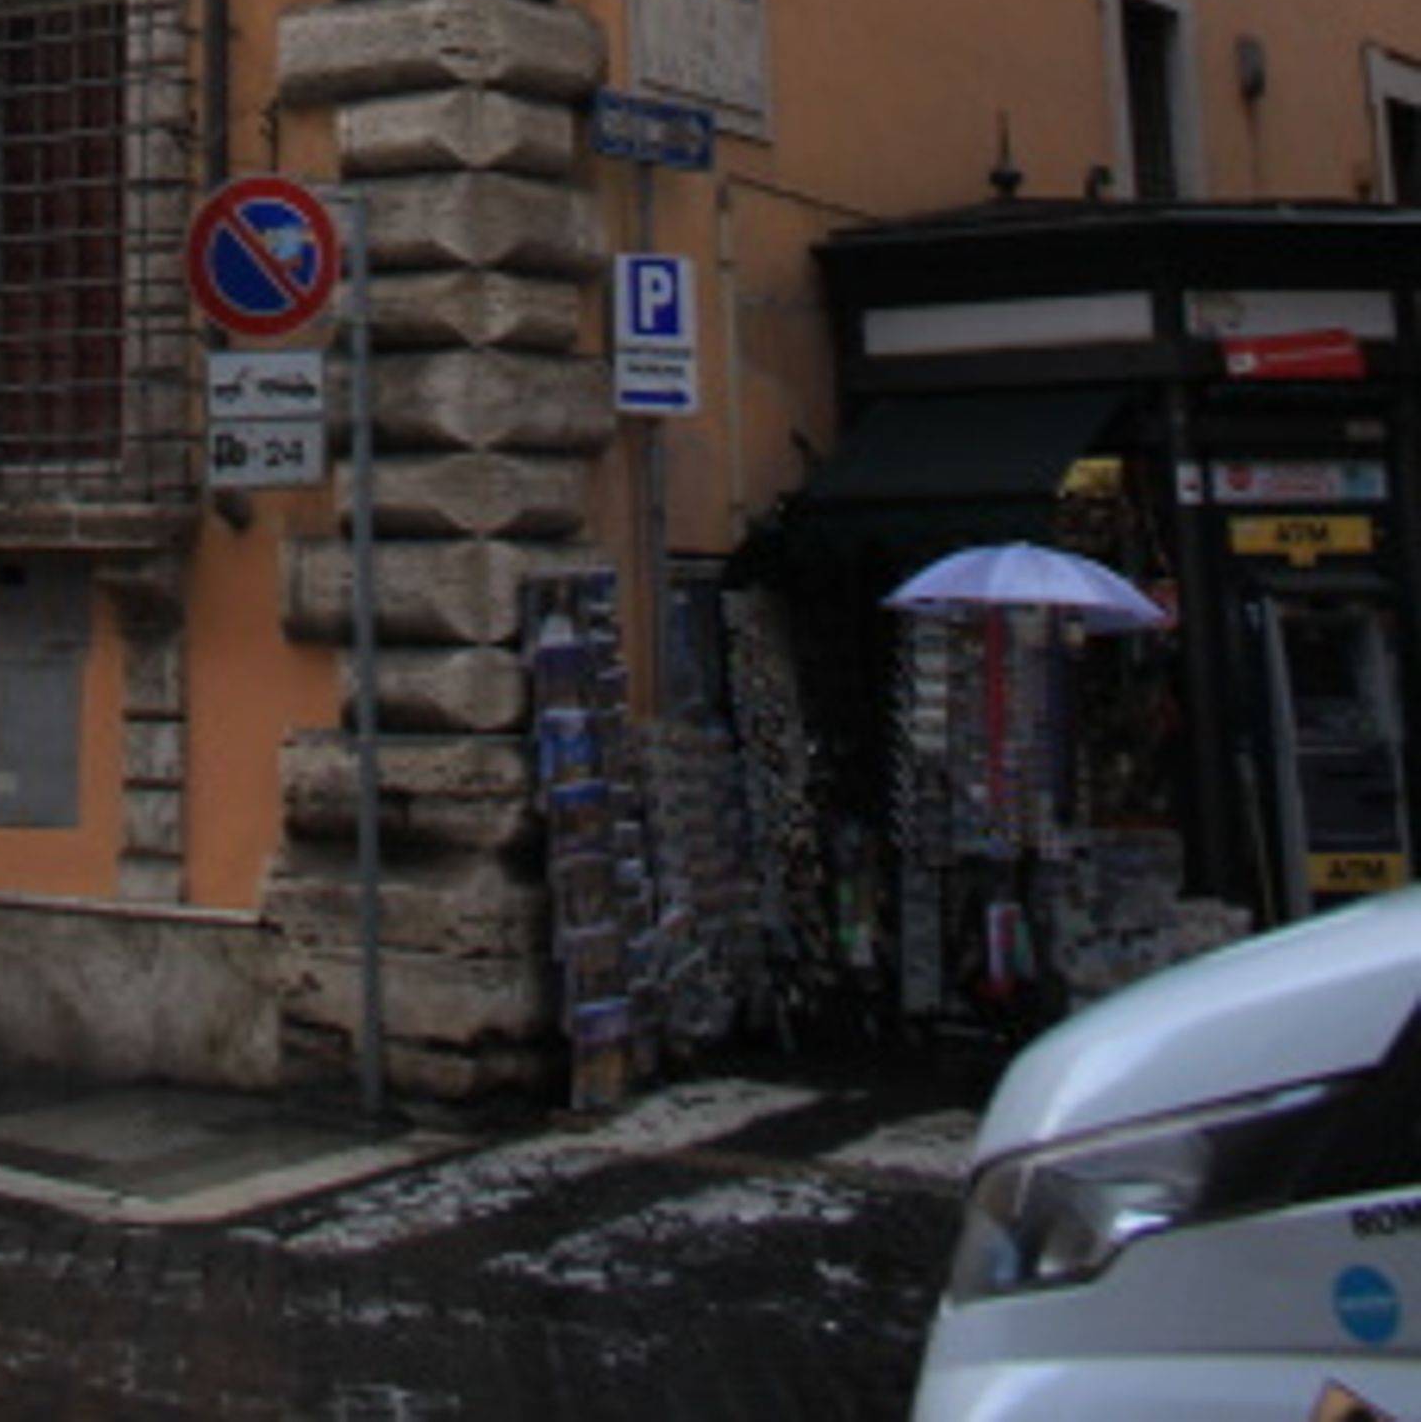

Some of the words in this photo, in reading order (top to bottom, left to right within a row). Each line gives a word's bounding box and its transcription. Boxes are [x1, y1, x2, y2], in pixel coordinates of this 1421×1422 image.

[639, 265, 672, 329] P
[1276, 522, 1329, 543] ATM
[1328, 858, 1387, 879] ATM
